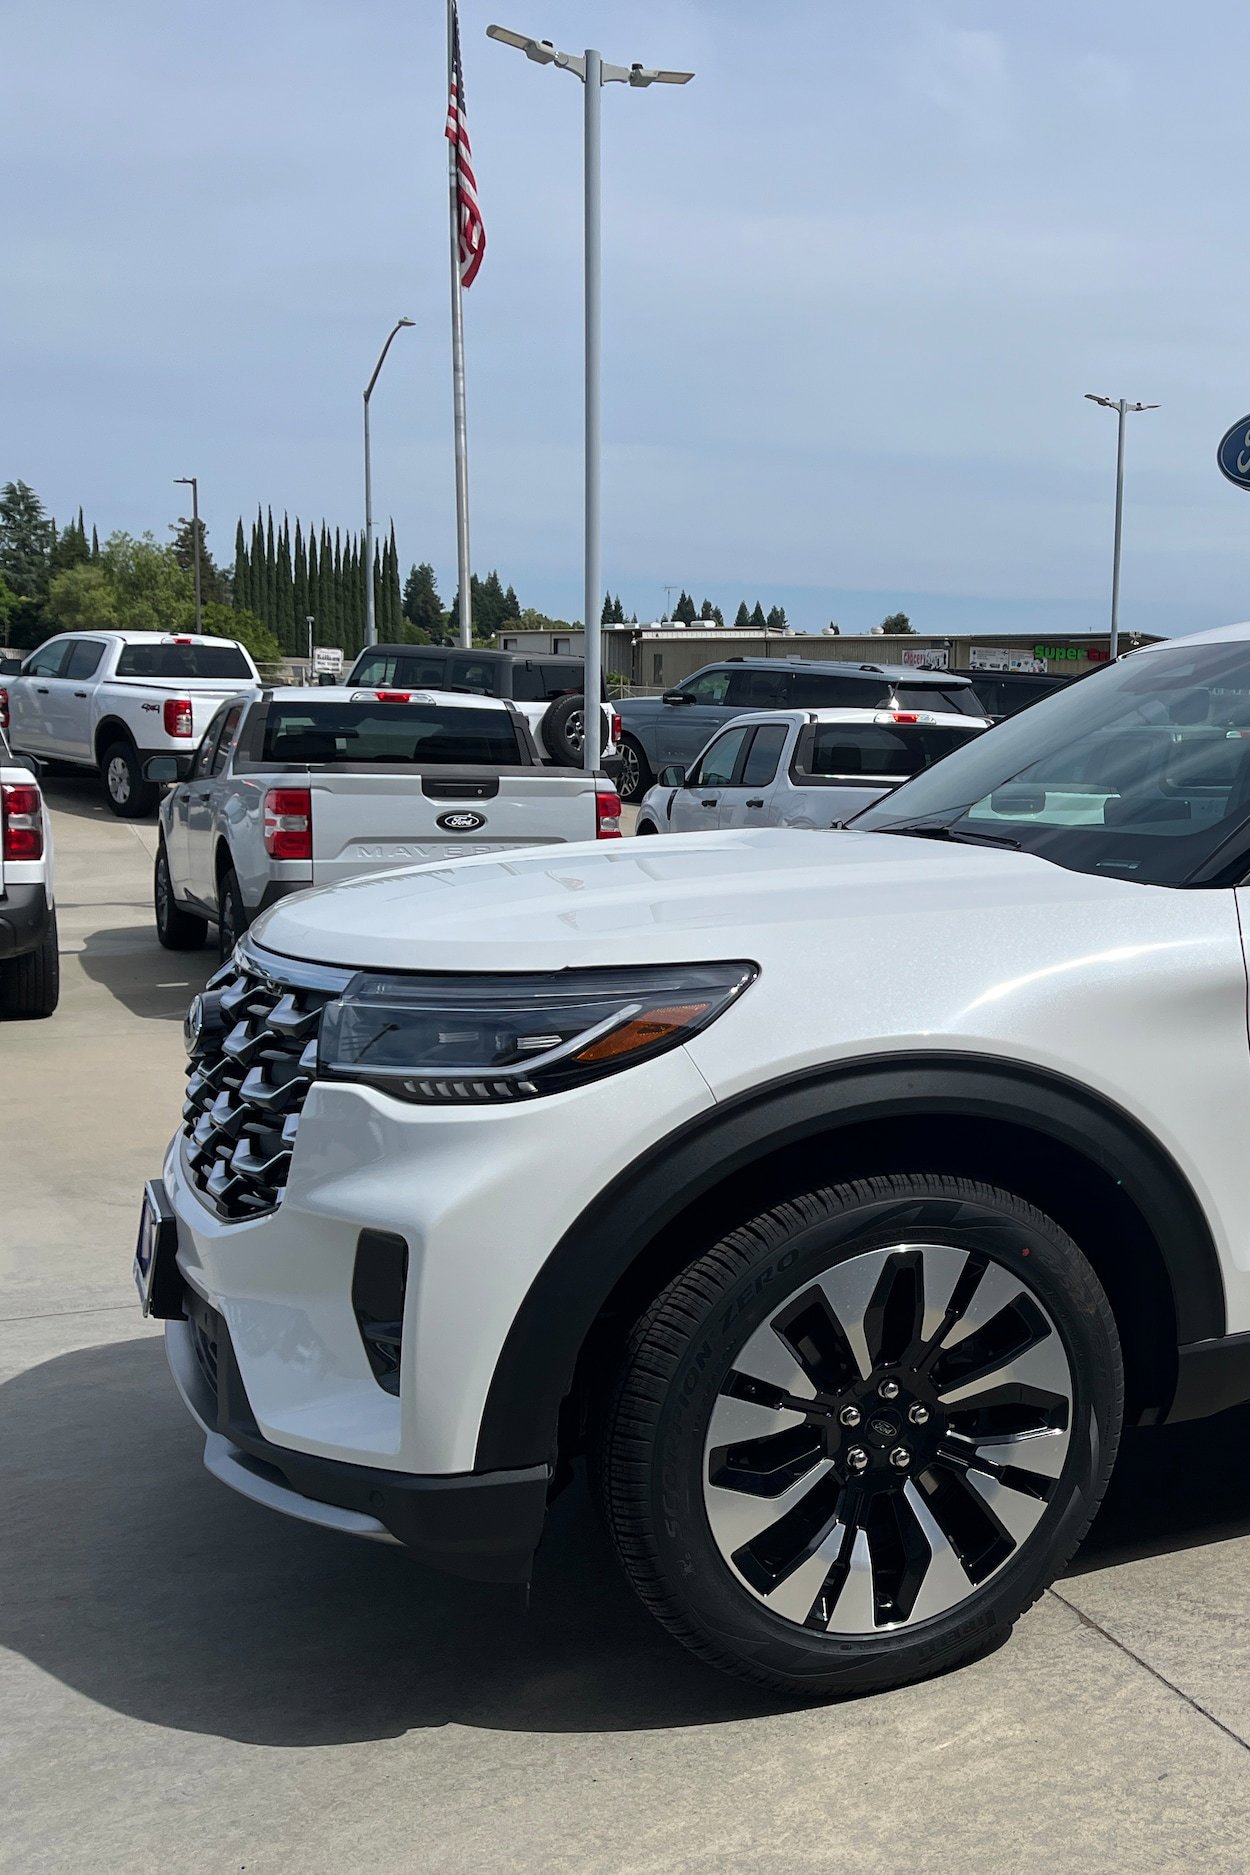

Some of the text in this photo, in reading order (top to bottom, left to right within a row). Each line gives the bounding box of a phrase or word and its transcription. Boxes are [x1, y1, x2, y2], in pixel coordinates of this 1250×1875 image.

[1034, 644, 1086, 661] Super
[451, 815, 473, 826] Ford
[718, 1248, 800, 1335] ZERO
